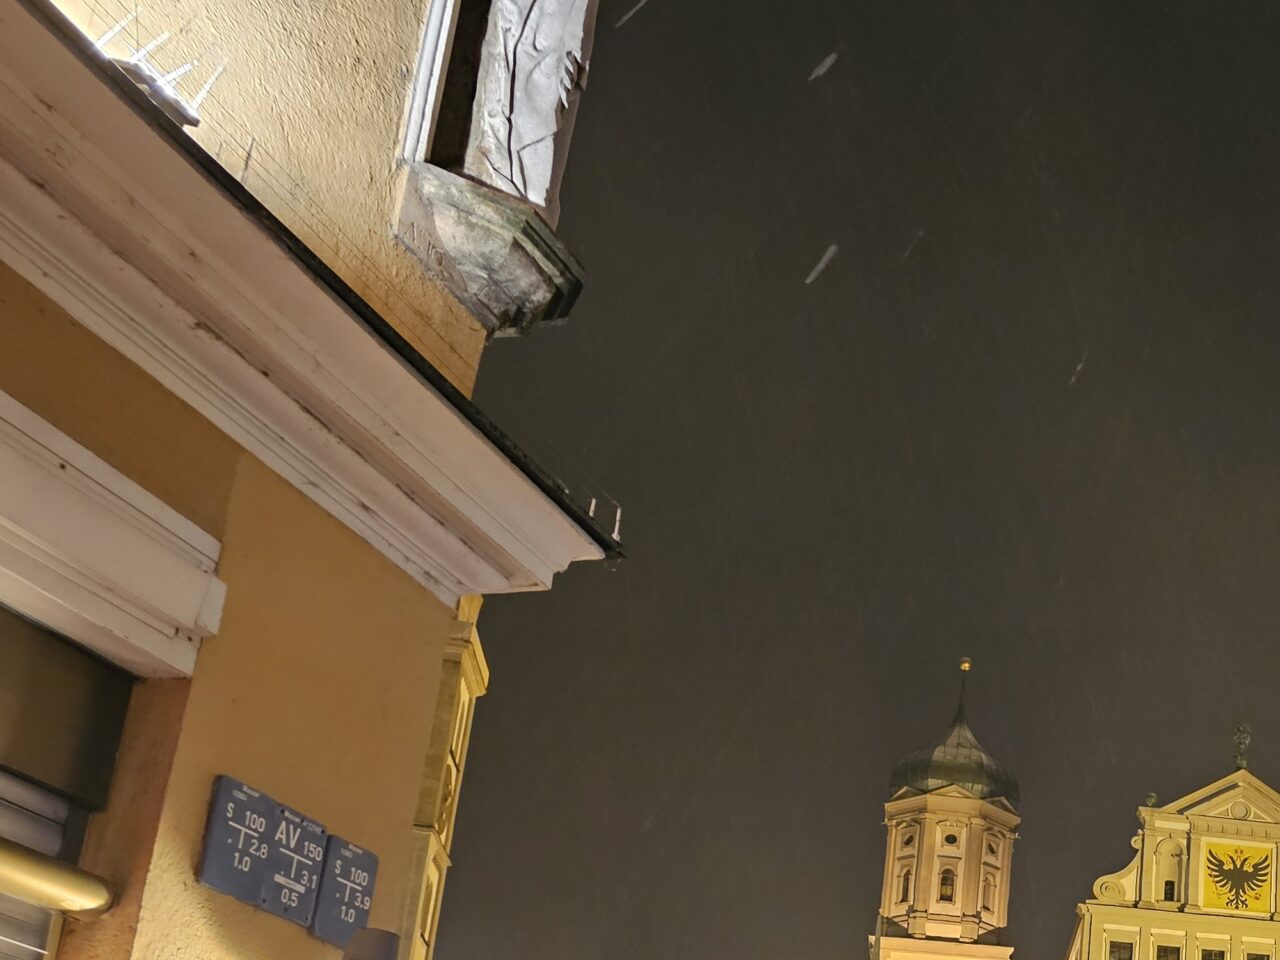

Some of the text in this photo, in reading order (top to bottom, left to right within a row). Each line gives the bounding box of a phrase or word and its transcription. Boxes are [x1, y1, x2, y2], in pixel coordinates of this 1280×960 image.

[226, 803, 234, 818] S
[245, 811, 266, 832] 100
[275, 820, 301, 849] AV
[249, 839, 268, 859] 2,8
[303, 841, 323, 861] 150
[233, 852, 251, 872] 1,0
[300, 870, 318, 889] 3,1
[335, 859, 368, 886] S 100
[280, 888, 299, 907] 0,5
[354, 893, 371, 910] 3,9
[340, 906, 356, 923] 1,0
